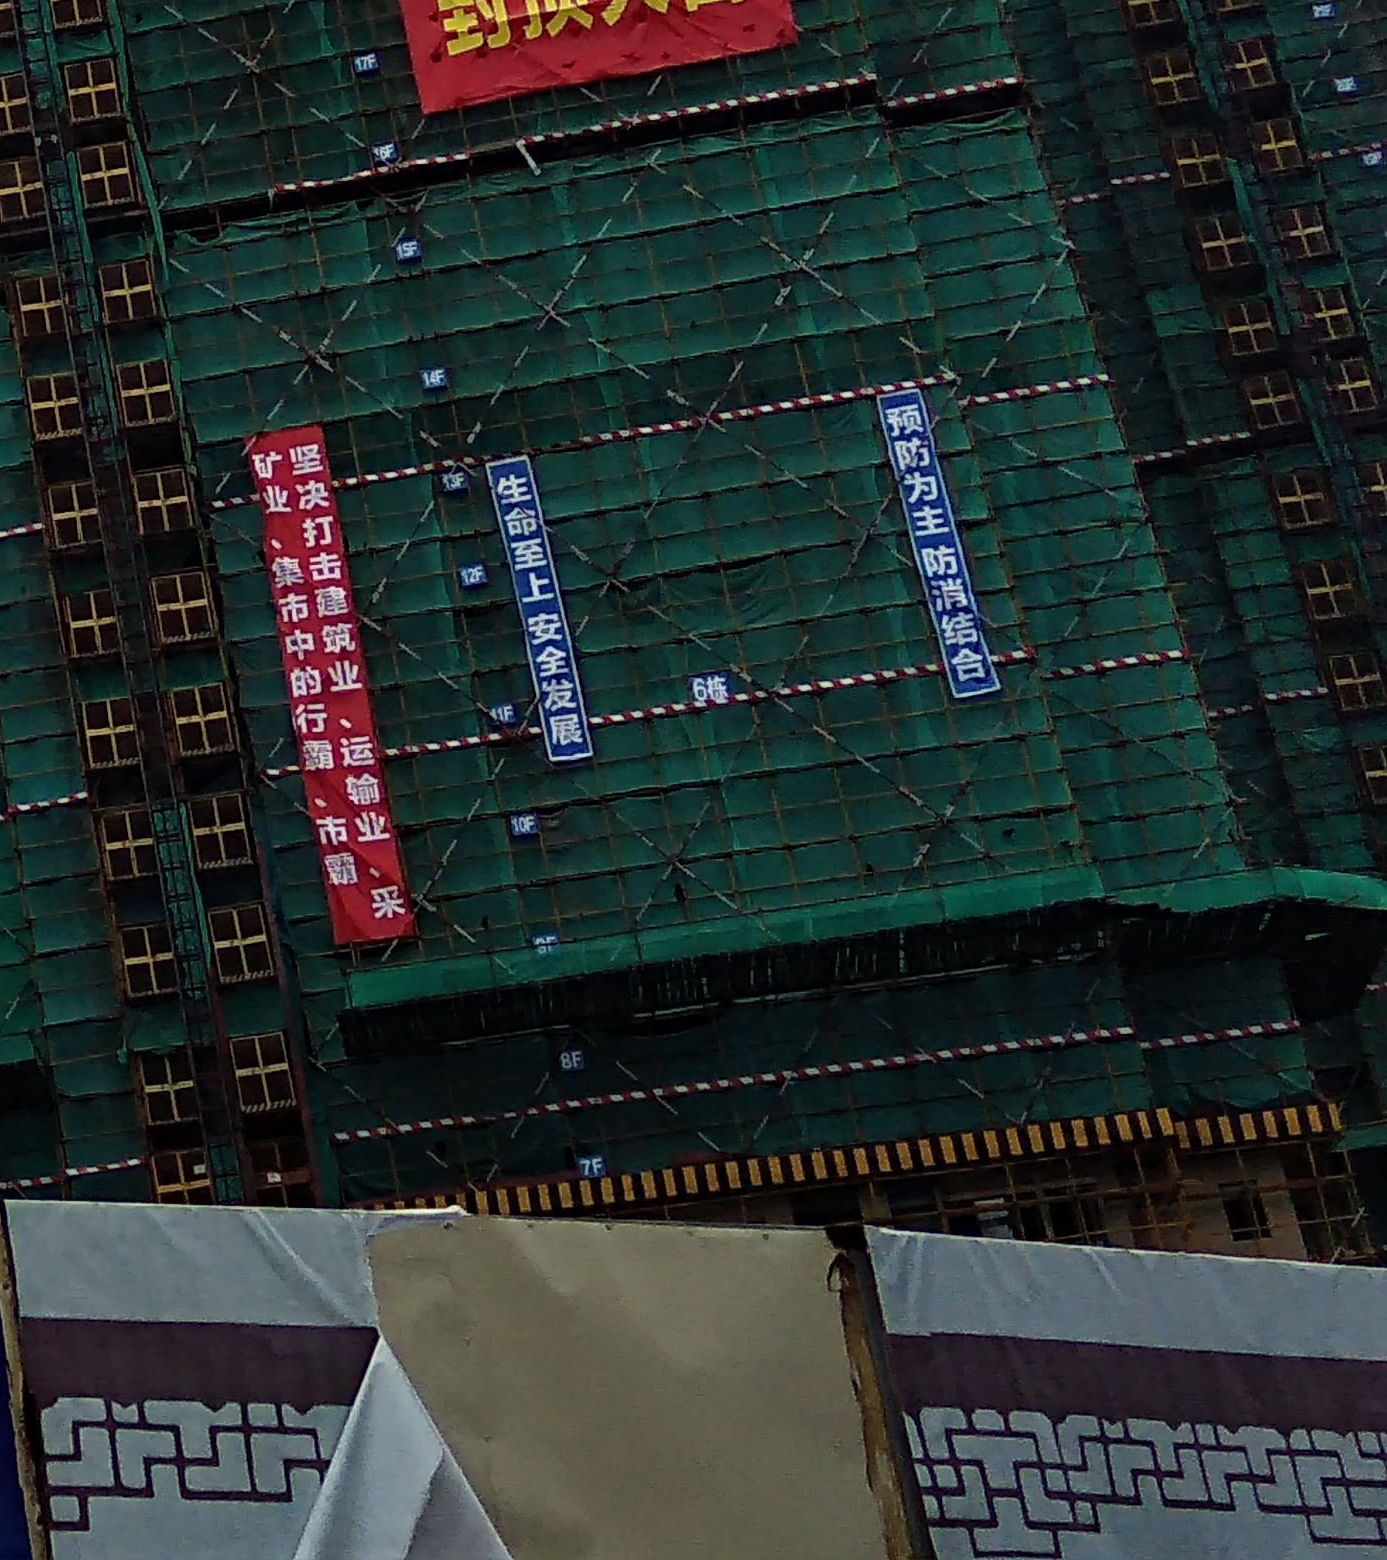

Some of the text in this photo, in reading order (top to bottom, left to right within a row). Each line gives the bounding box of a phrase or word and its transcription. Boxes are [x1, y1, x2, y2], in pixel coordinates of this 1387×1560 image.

[289, 443, 407, 919] 坚决打击建筑业、运输业、采
[496, 474, 585, 746] 生命至上安全发展
[885, 404, 986, 684] 预防为主防消结合
[692, 675, 728, 702] 6栋
